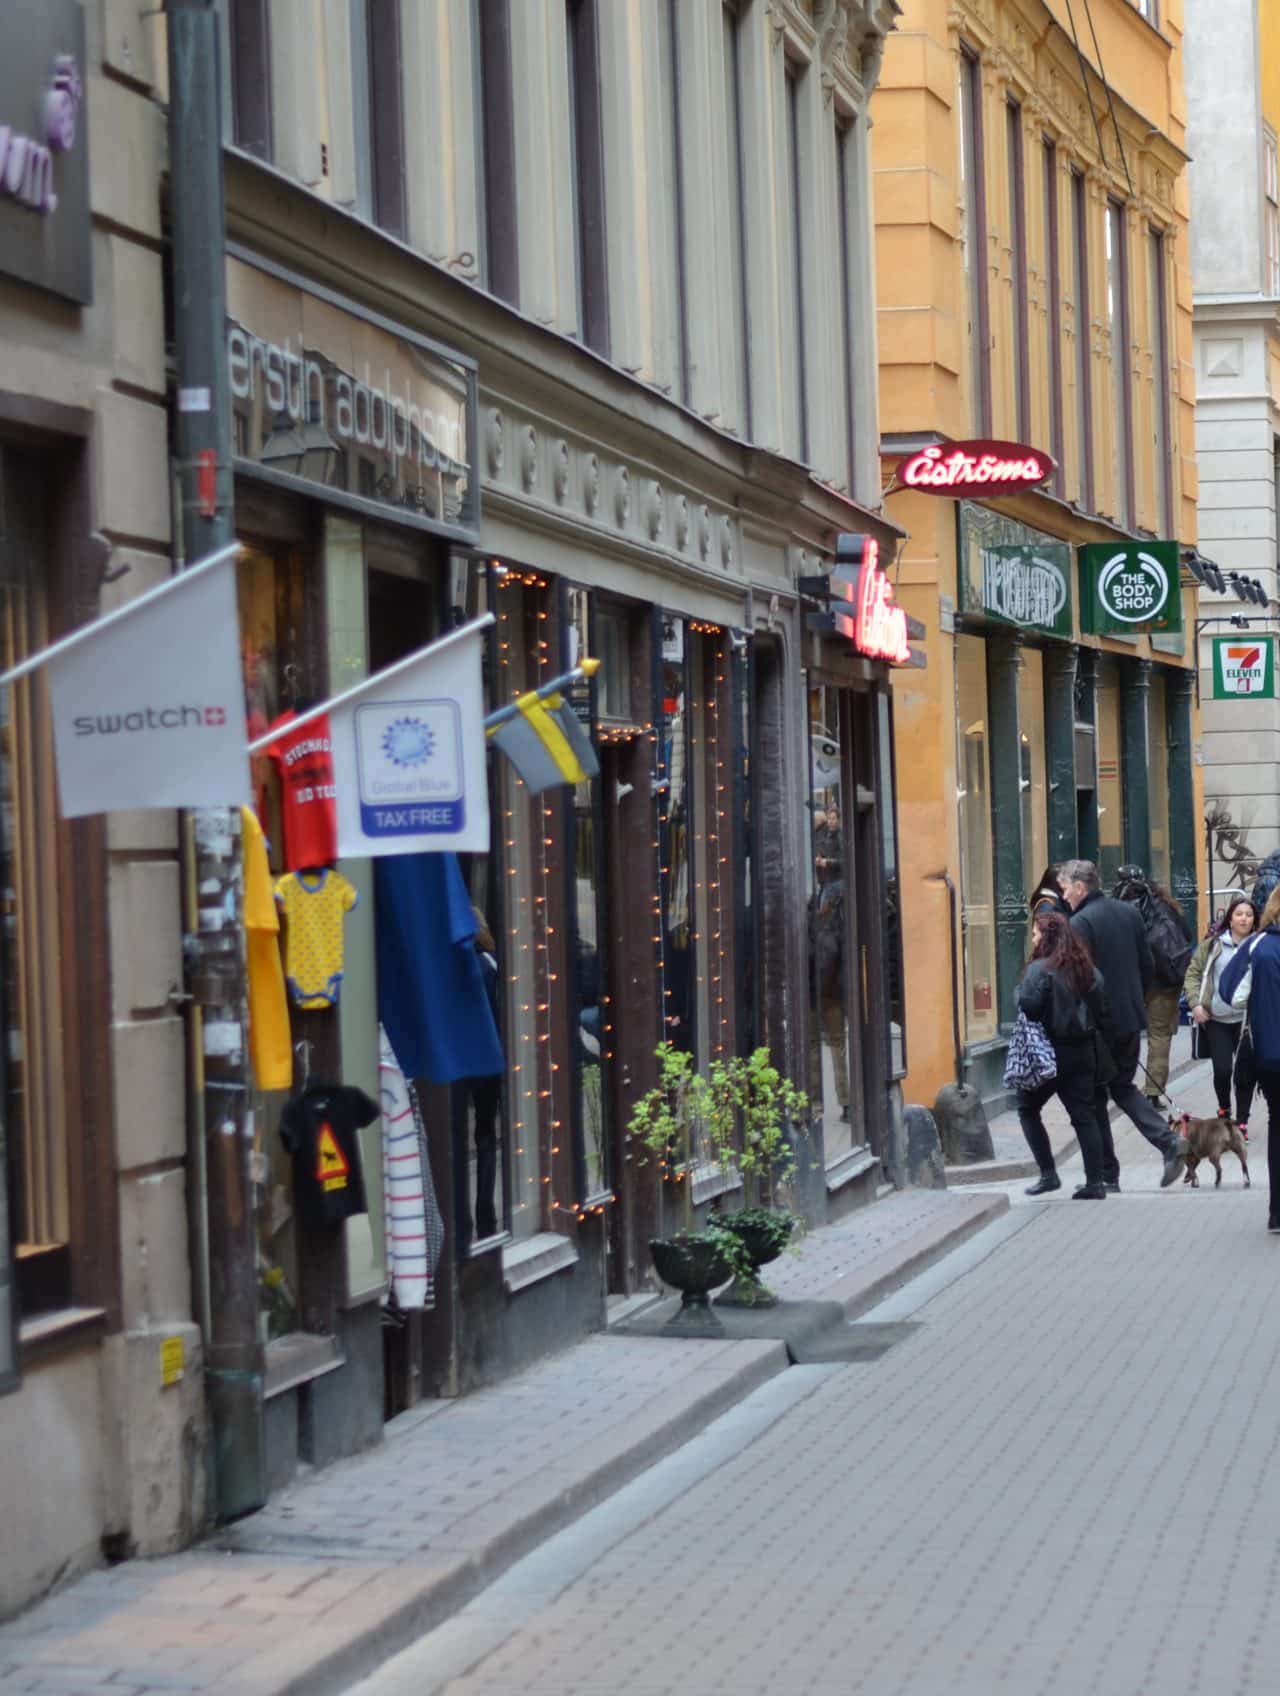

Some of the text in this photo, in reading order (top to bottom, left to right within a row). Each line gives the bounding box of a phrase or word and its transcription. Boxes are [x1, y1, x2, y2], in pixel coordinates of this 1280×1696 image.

[1121, 573, 1146, 584] THE
[1111, 584, 1155, 598] BODY
[1115, 597, 1154, 610] SHOP
[1227, 647, 1260, 668] 7
[72, 704, 202, 737] swatch
[373, 807, 453, 829] TAX FREE
